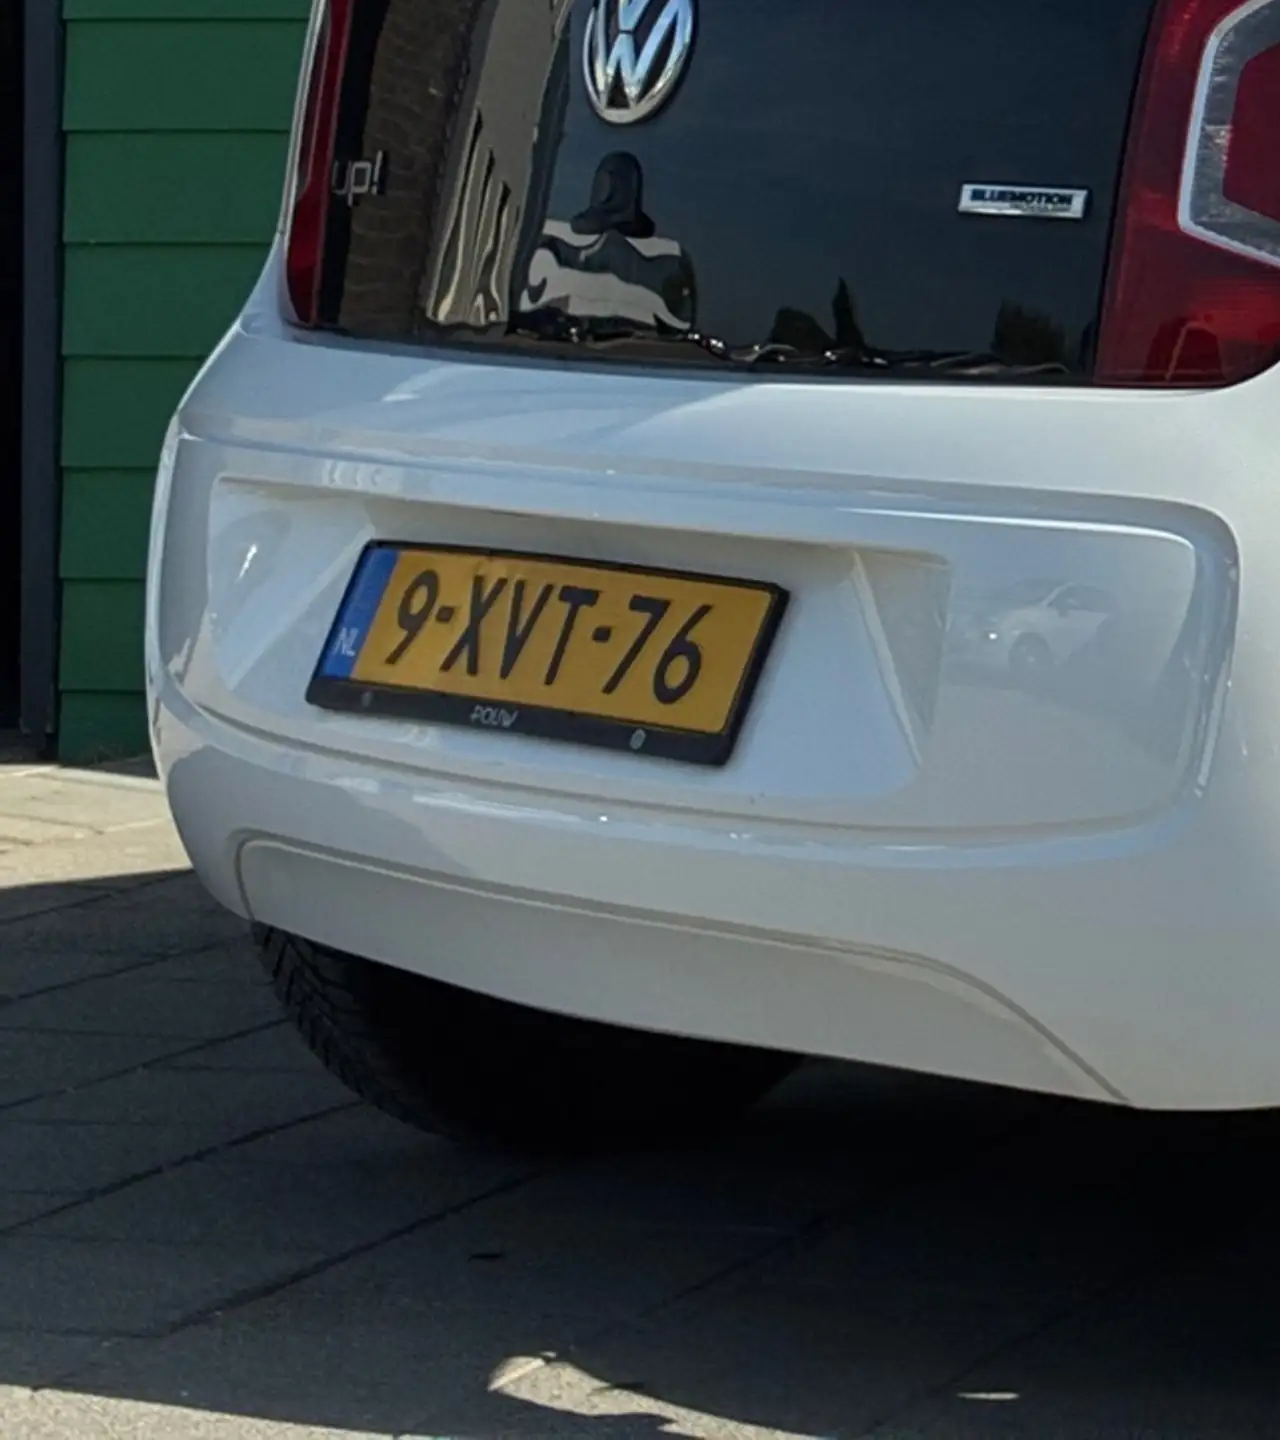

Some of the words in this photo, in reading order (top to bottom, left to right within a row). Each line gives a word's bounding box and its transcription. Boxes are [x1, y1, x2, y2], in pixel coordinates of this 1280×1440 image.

[331, 149, 383, 207] up!
[331, 627, 359, 657] NL
[385, 570, 712, 705] 9-XVT-76
